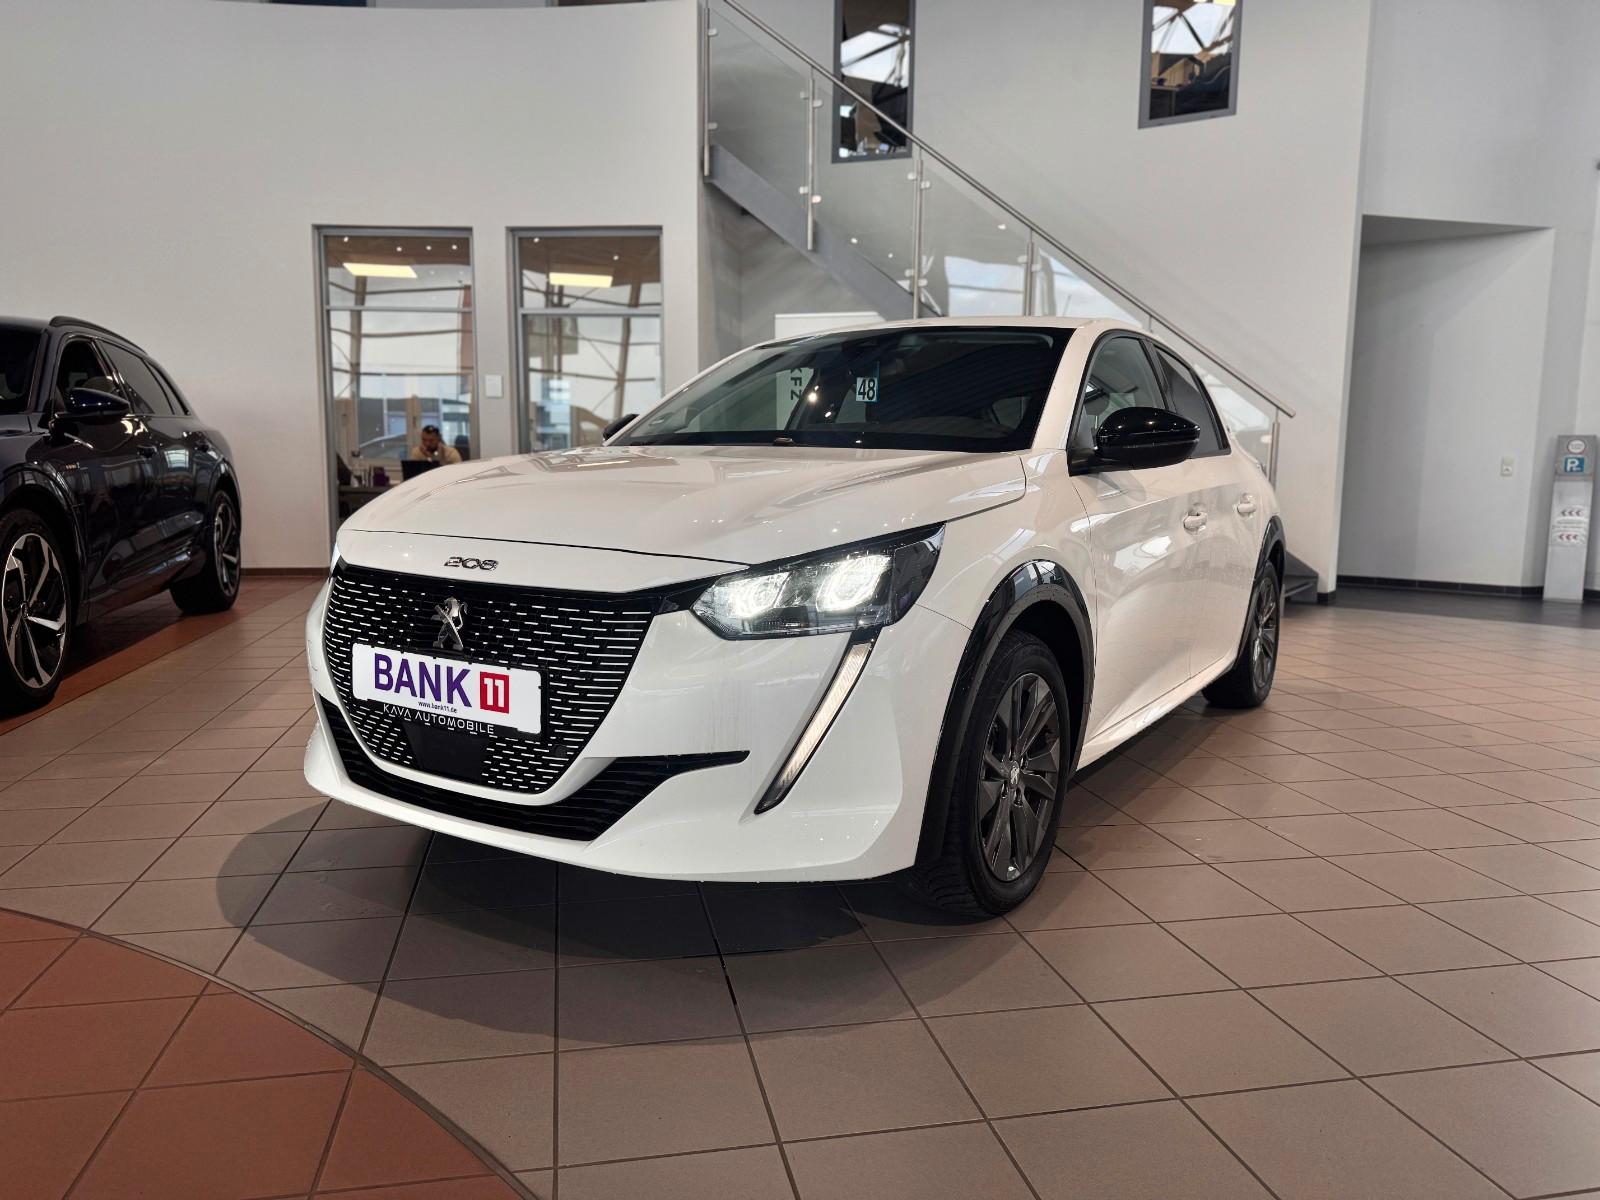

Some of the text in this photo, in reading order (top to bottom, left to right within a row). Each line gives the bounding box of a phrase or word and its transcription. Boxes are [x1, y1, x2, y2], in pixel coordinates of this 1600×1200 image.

[857, 378, 876, 401] 48
[444, 556, 499, 571] 208
[374, 652, 505, 709] BANK 11
[418, 700, 458, 714] www.bank11.de
[383, 703, 495, 735] KAVA AUTOMOBILE
